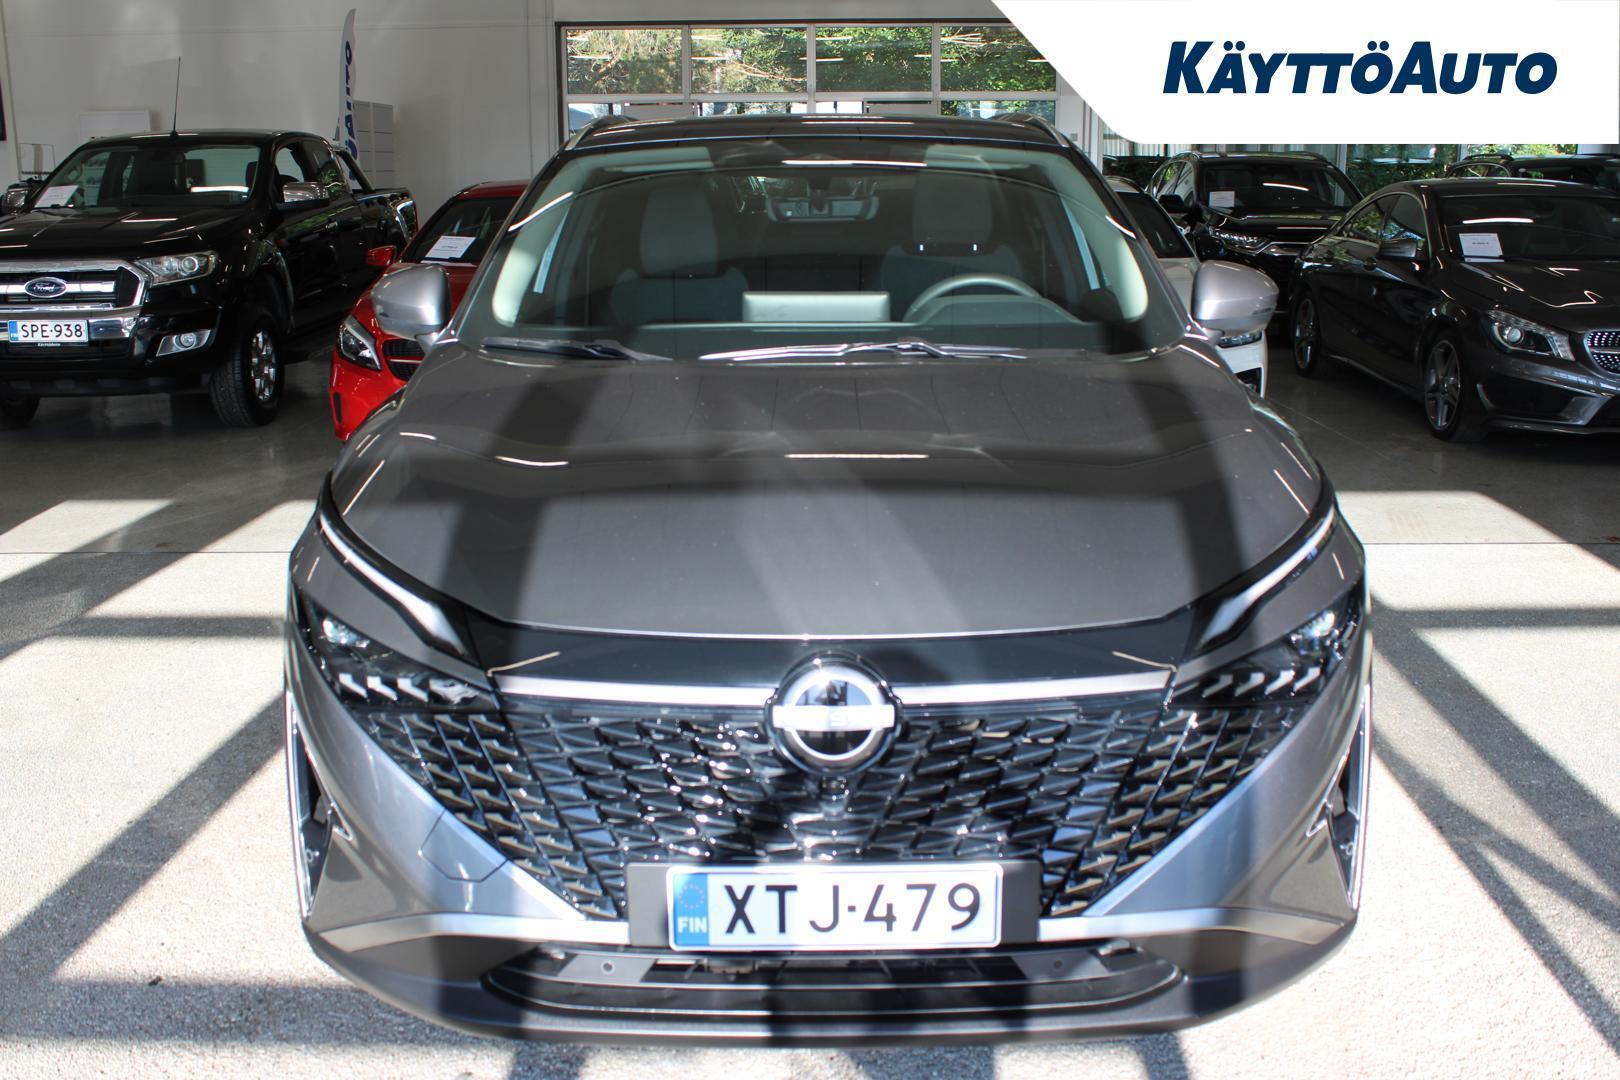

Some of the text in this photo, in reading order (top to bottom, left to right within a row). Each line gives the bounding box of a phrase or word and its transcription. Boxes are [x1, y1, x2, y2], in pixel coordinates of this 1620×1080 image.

[21, 323, 83, 338] SPE-938
[724, 883, 981, 935] XTJ-479
[677, 917, 708, 934] FIN
